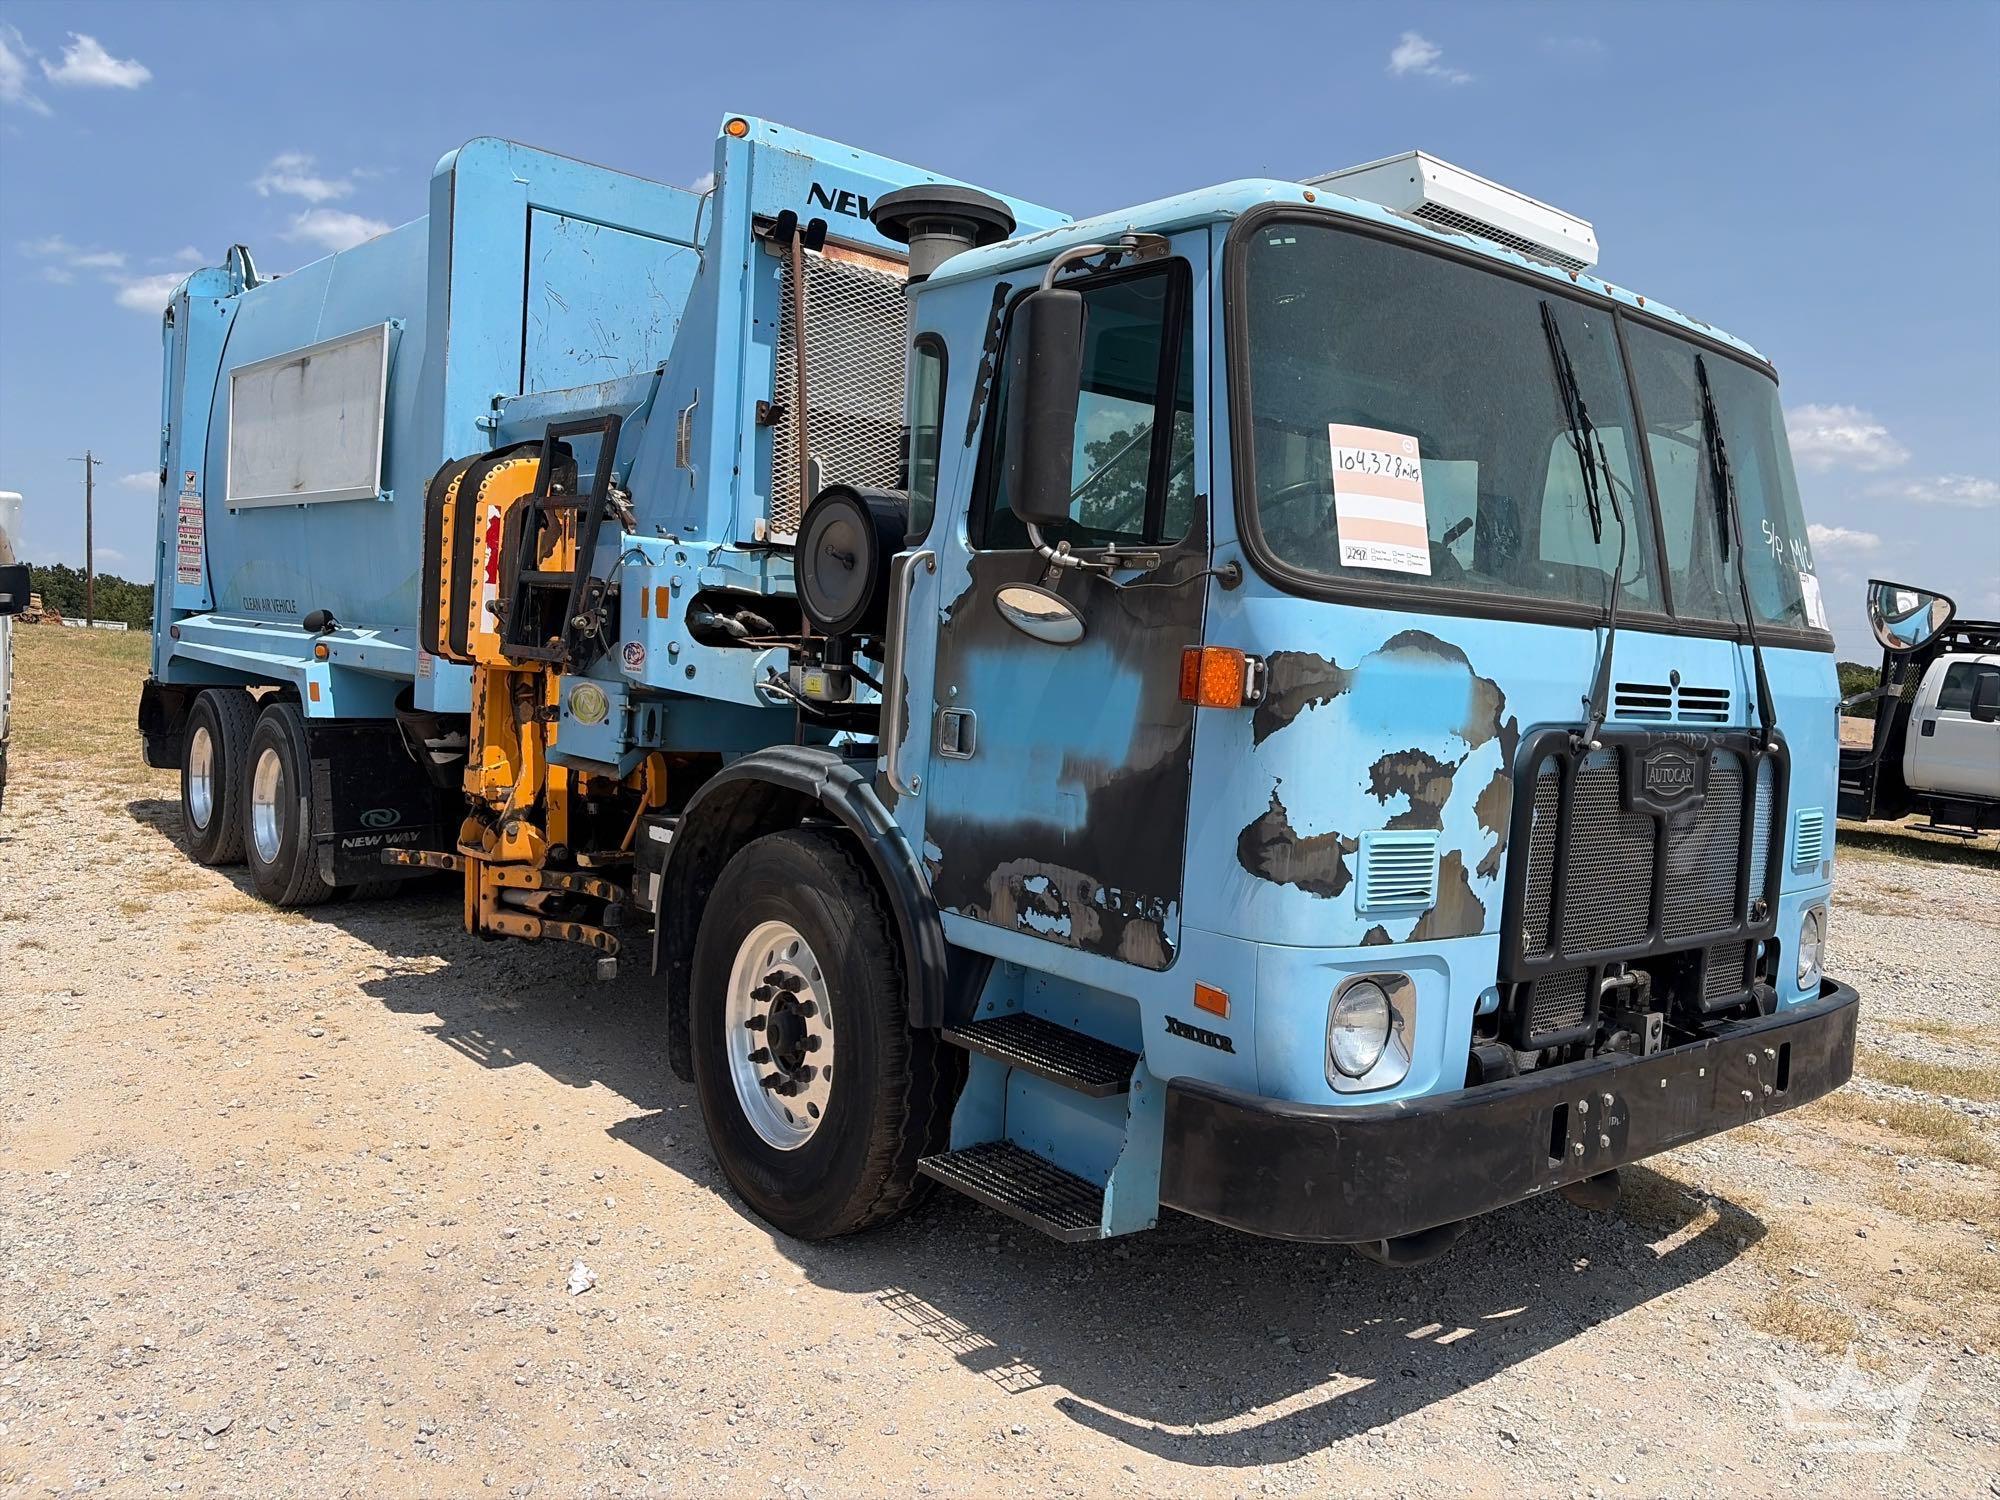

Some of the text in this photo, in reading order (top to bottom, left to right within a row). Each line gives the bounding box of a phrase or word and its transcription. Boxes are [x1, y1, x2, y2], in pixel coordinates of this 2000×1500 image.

[243, 597, 297, 614] CLEAN AIR VEHICLE
[1648, 767, 1692, 783] AUTOCAR
[342, 831, 420, 848] NEW WAY
